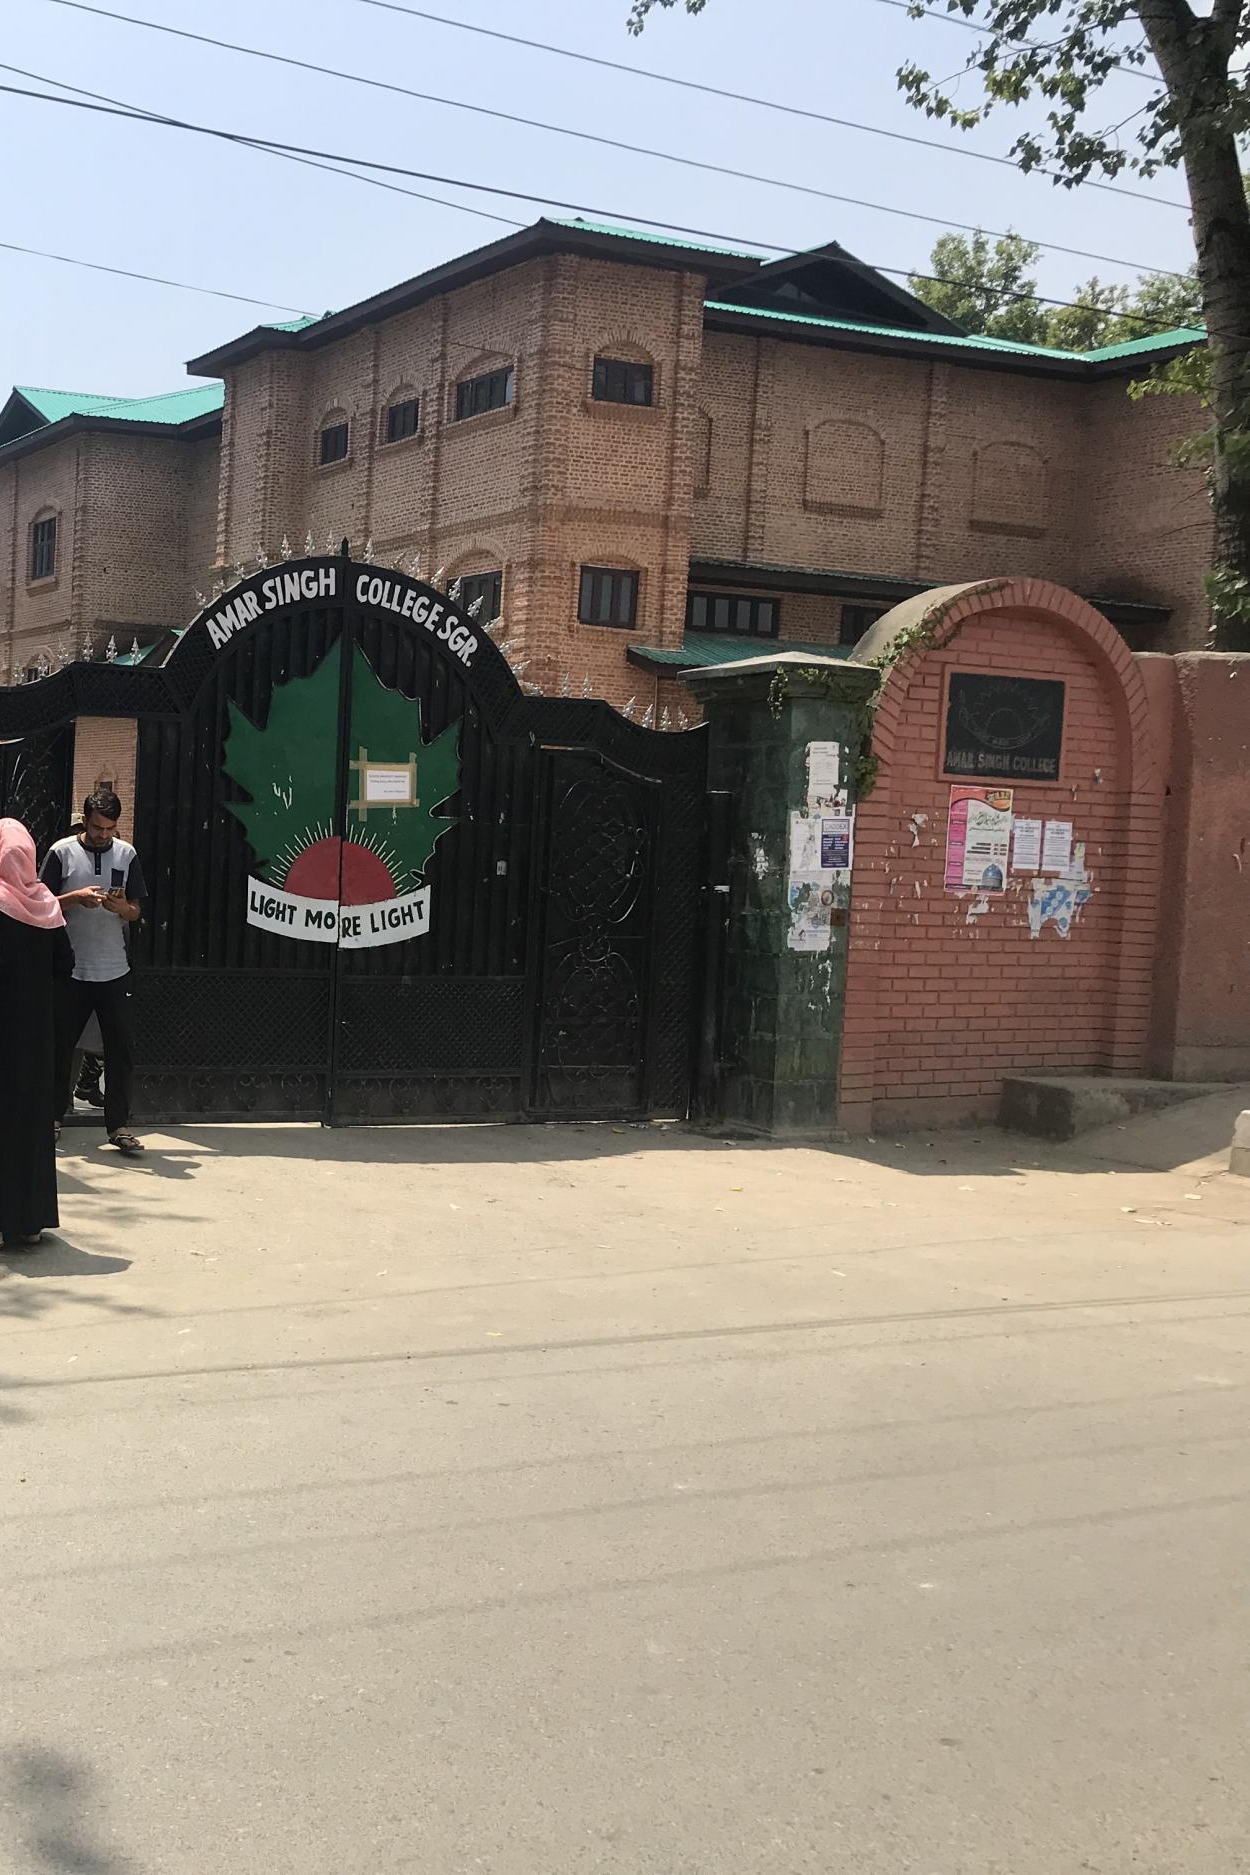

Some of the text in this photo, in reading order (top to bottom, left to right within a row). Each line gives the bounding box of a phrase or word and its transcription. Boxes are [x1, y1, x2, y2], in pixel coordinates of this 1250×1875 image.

[205, 568, 478, 667] AMAR SINGH COLLEGE SGR.
[250, 890, 424, 938] LIGHT MORE LIGHT
